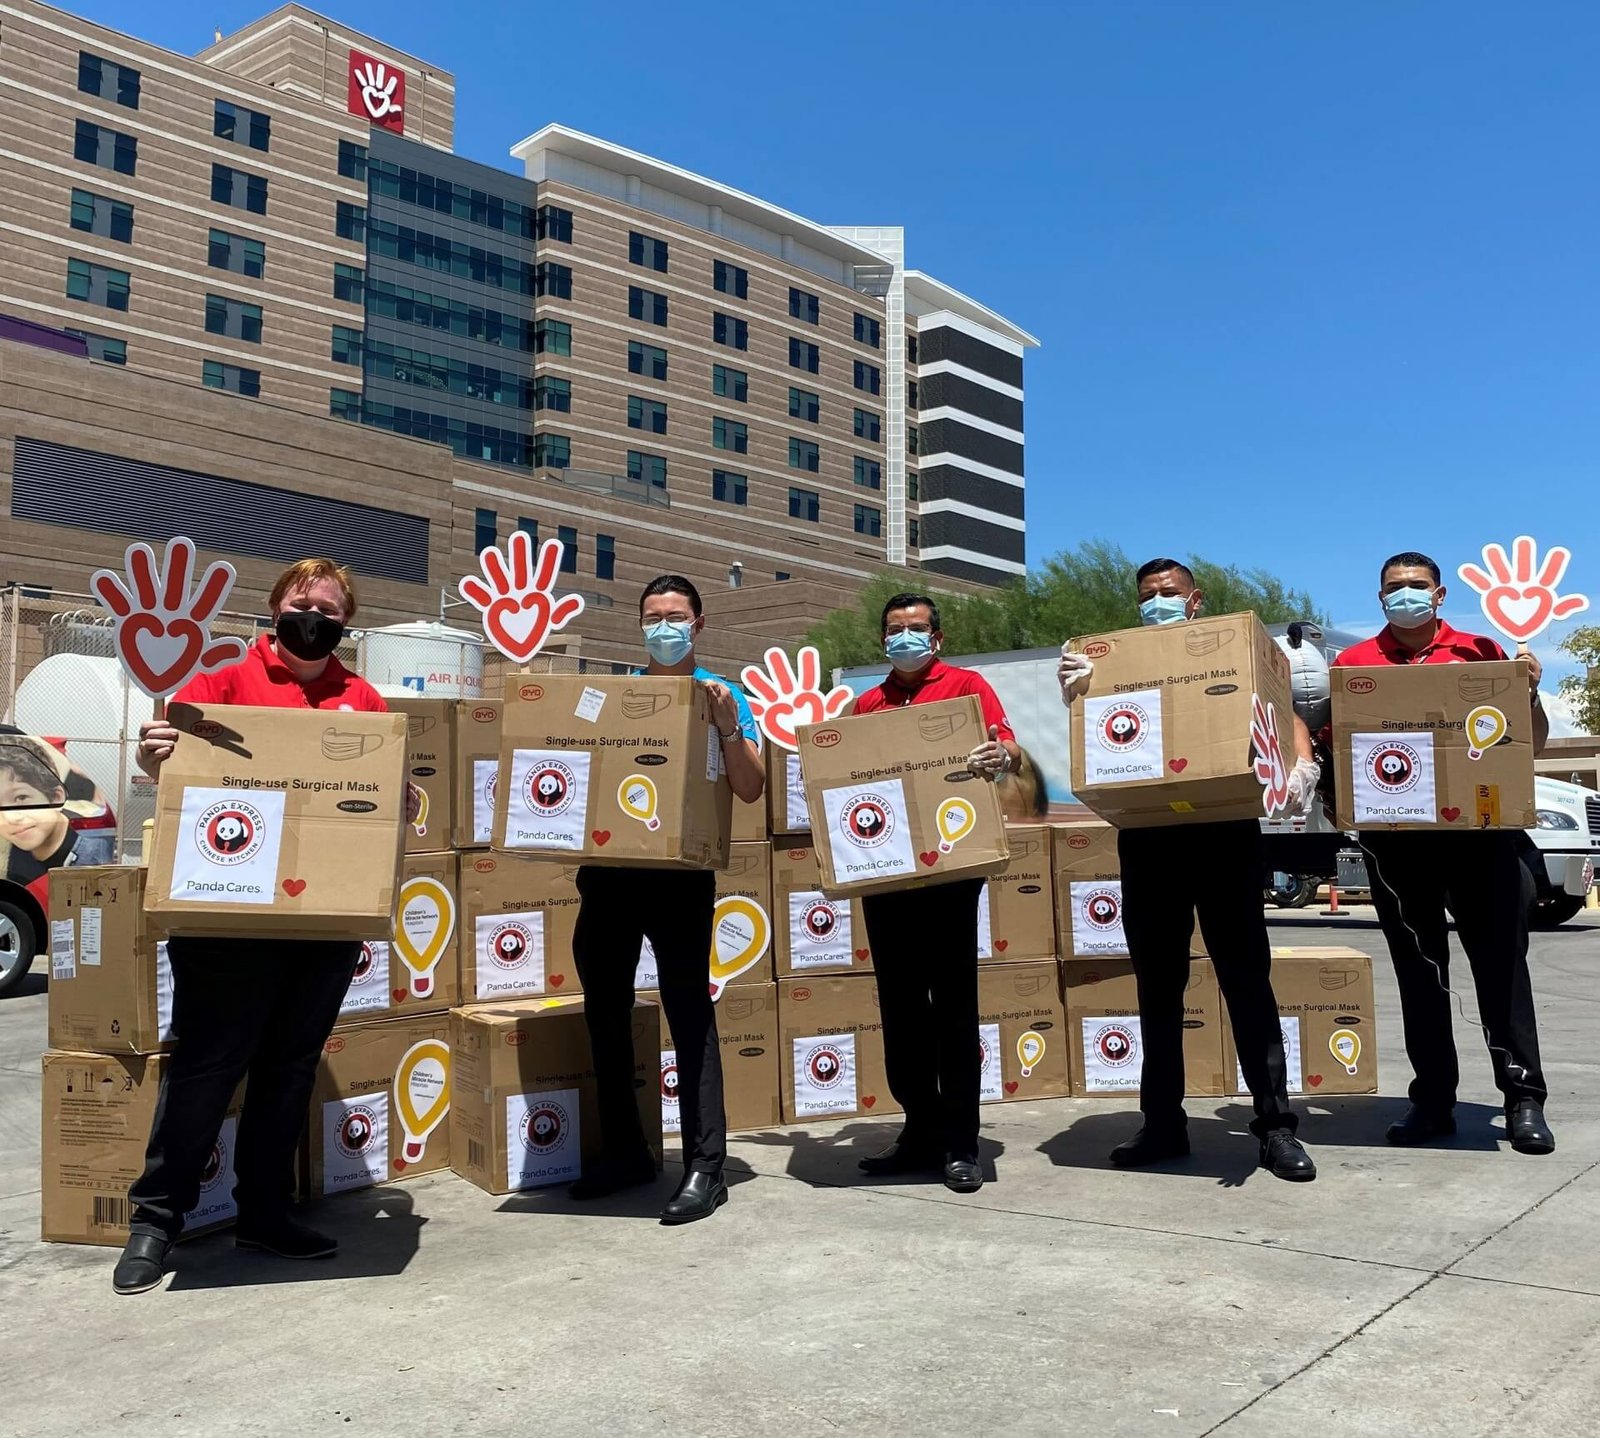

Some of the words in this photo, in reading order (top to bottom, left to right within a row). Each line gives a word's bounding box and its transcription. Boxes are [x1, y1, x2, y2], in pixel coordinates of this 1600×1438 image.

[1086, 645, 1107, 655] BYD
[427, 673, 451, 683] AIR
[1113, 679, 1164, 693] Single-use
[1167, 672, 1207, 685] Surgical
[1210, 668, 1238, 679] Mask
[1350, 681, 1373, 690] BYD
[474, 711, 494, 719] BYD
[1099, 706, 1118, 727] PANDA
[1119, 704, 1147, 723] EXPRESS
[1381, 720, 1436, 730] Single-use
[1438, 720, 1465, 730] Surgi
[545, 736, 597, 747] Single-use
[599, 737, 640, 748] Surgical
[642, 738, 670, 747] Mask
[815, 733, 838, 744] BYD
[416, 753, 437, 761] Mask
[1367, 744, 1388, 766] PANDA
[1389, 743, 1419, 765] EXPRESS
[850, 765, 902, 780] Single-use
[905, 758, 945, 772] Surgical
[947, 753, 970, 765] Mas
[1096, 766, 1125, 776] Panda
[525, 763, 547, 785] PANDA
[548, 762, 574, 787] EXPRESS
[222, 776, 288, 789] Single-use
[292, 779, 343, 792] Surgical
[347, 781, 380, 792] Mask
[1370, 774, 1393, 792] CHINESE
[1394, 774, 1417, 792] KITCHEN
[340, 802, 373, 811] Non-Sterile
[525, 794, 546, 815] CHINESE
[547, 796, 571, 815] KITCHEN
[842, 798, 860, 822] PANDA
[861, 795, 891, 816] EXPRESS
[1366, 806, 1396, 815] Panda
[199, 804, 227, 829] PANDA
[230, 802, 263, 831] EXPRESS
[517, 830, 546, 840] Panda
[846, 830, 870, 846] CHINESE
[872, 824, 892, 845] KITCHEN
[199, 839, 225, 863] CHINESE
[228, 842, 259, 863] KITCHEN
[476, 862, 494, 870] BYD
[846, 862, 876, 873] Panda
[990, 873, 1020, 882] Surgical
[186, 880, 224, 892] Panda
[737, 890, 759, 898] Mask
[502, 900, 546, 910] Single-use
[548, 896, 581, 906] Surgical
[1083, 891, 1099, 909] PANDA
[801, 901, 817, 920] PANDA
[818, 900, 840, 919] EXPRESS
[489, 925, 507, 945] PANDA
[507, 923, 531, 943] EXPRESS
[490, 953, 510, 968] CHINESE
[511, 950, 531, 967] KITCHEN
[800, 954, 823, 962] Panda
[487, 983, 513, 991] Panda
[793, 990, 809, 998] BYD
[341, 1000, 359, 1008] anda
[1278, 1003, 1302, 1011] le-use
[1303, 1003, 1337, 1012] Surgical
[1338, 1003, 1361, 1011] Mask
[1001, 1010, 1032, 1019] Surgical
[1033, 1008, 1053, 1017] Mask
[817, 1025, 857, 1035] Single-use
[858, 1023, 883, 1032] Surgic
[719, 1034, 742, 1045] rgical
[743, 1033, 765, 1042] Mask
[1095, 1027, 1111, 1044] PANDA
[1111, 1026, 1135, 1044] EXPRESS
[326, 1041, 343, 1049] BYD
[806, 1047, 821, 1066] PANDA
[822, 1045, 844, 1064] EXPRESS
[412, 1070, 433, 1079] Children's
[535, 1074, 583, 1085] Single-use
[350, 1077, 392, 1090] Single-use
[1094, 1078, 1119, 1086] Panda
[804, 1101, 828, 1109] Panda
[337, 1110, 353, 1133] PANDA
[354, 1107, 377, 1127] EXPRESS
[522, 1105, 539, 1128] PANDA
[541, 1103, 567, 1123] EXPRESS
[333, 1174, 358, 1184] Panda
[519, 1168, 547, 1180] Panda
